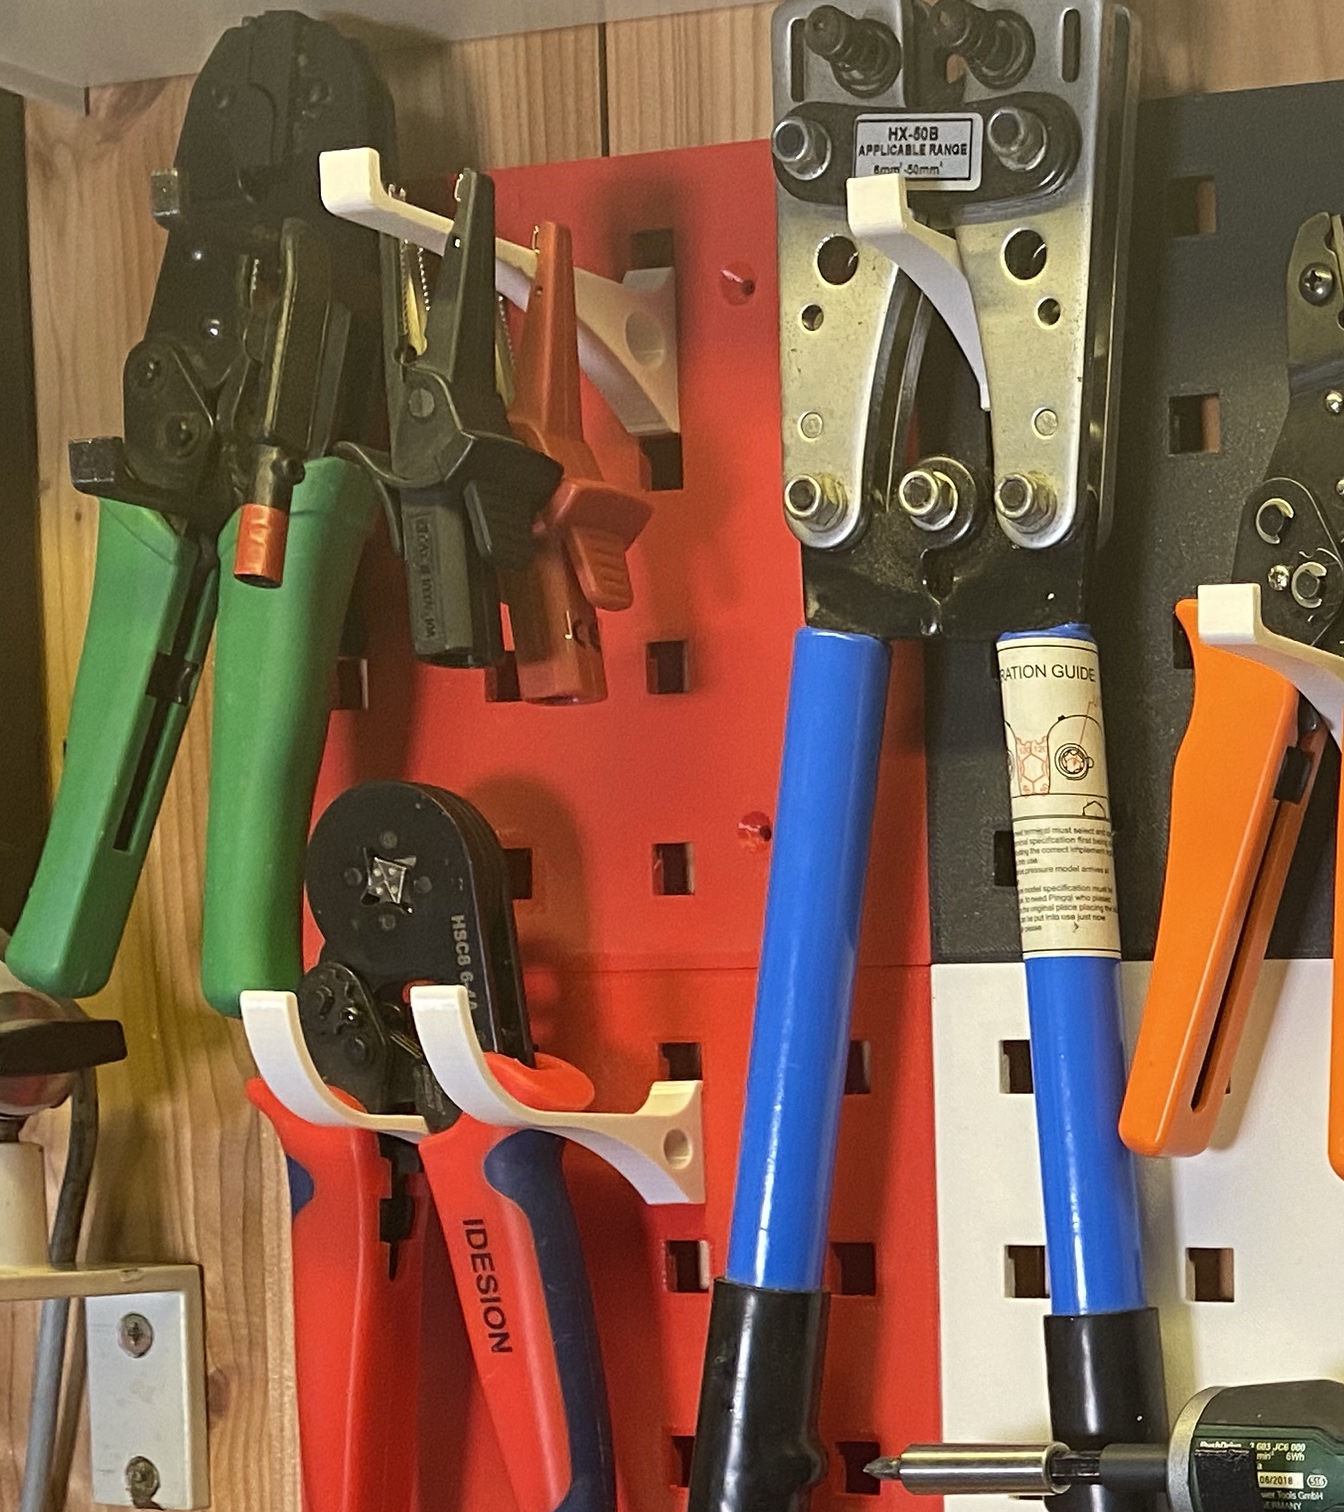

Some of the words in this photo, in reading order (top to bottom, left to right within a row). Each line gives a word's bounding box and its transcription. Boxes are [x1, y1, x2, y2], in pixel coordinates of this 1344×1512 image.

[858, 144, 926, 156] APPLICABLE
[929, 143, 968, 156] RANGE
[1051, 664, 1097, 683] GUIDE
[450, 914, 471, 966] HSC8
[461, 1218, 513, 1355] IDESION
[1256, 1442, 1271, 1451] 603
[1291, 1443, 1306, 1451] 000
[1286, 1453, 1305, 1461] 6Wh
[1260, 1477, 1293, 1485] 06/2018
[1298, 1491, 1323, 1500] GmbH
